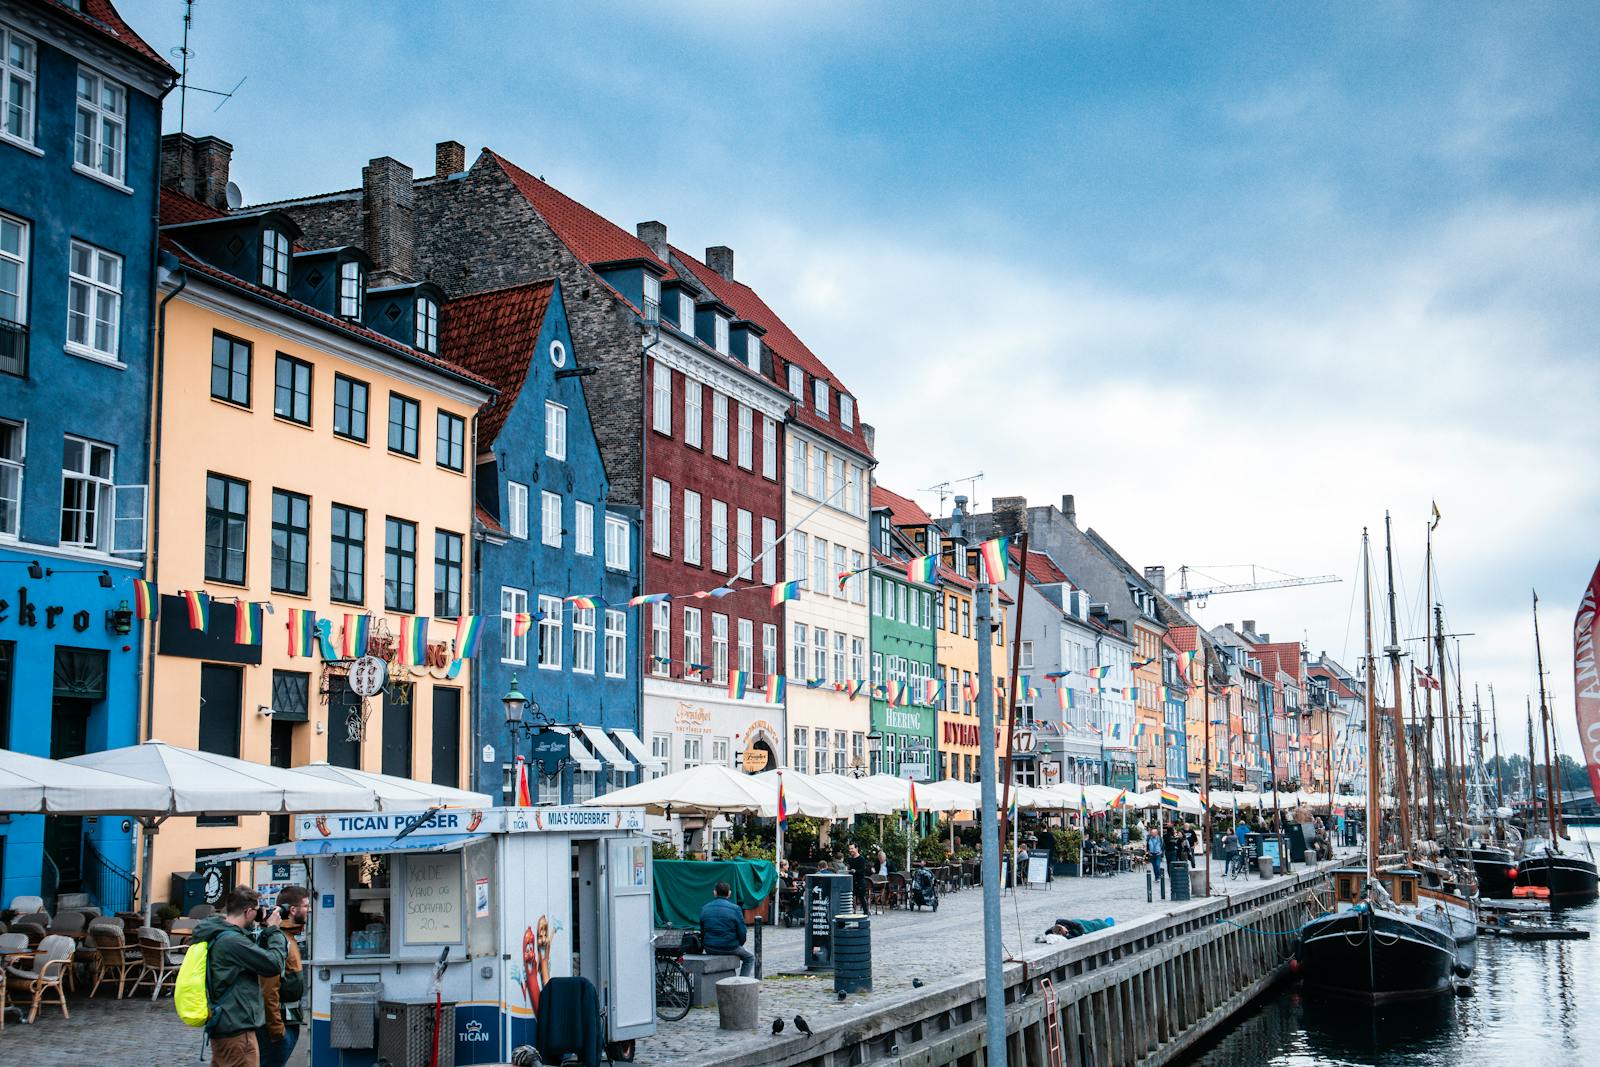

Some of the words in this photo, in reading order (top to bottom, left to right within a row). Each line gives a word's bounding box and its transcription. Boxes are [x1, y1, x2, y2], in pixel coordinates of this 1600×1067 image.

[886, 708, 921, 730] HEERING
[943, 721, 981, 747] NYHAV
[1014, 732, 1032, 751] 17
[339, 815, 389, 831] TICAN
[513, 821, 529, 830] TICAN
[548, 812, 568, 825] MIA'S
[570, 812, 610, 825] FODERBRÆT
[626, 819, 639, 828] TICAN
[459, 1032, 489, 1042] TICAN
